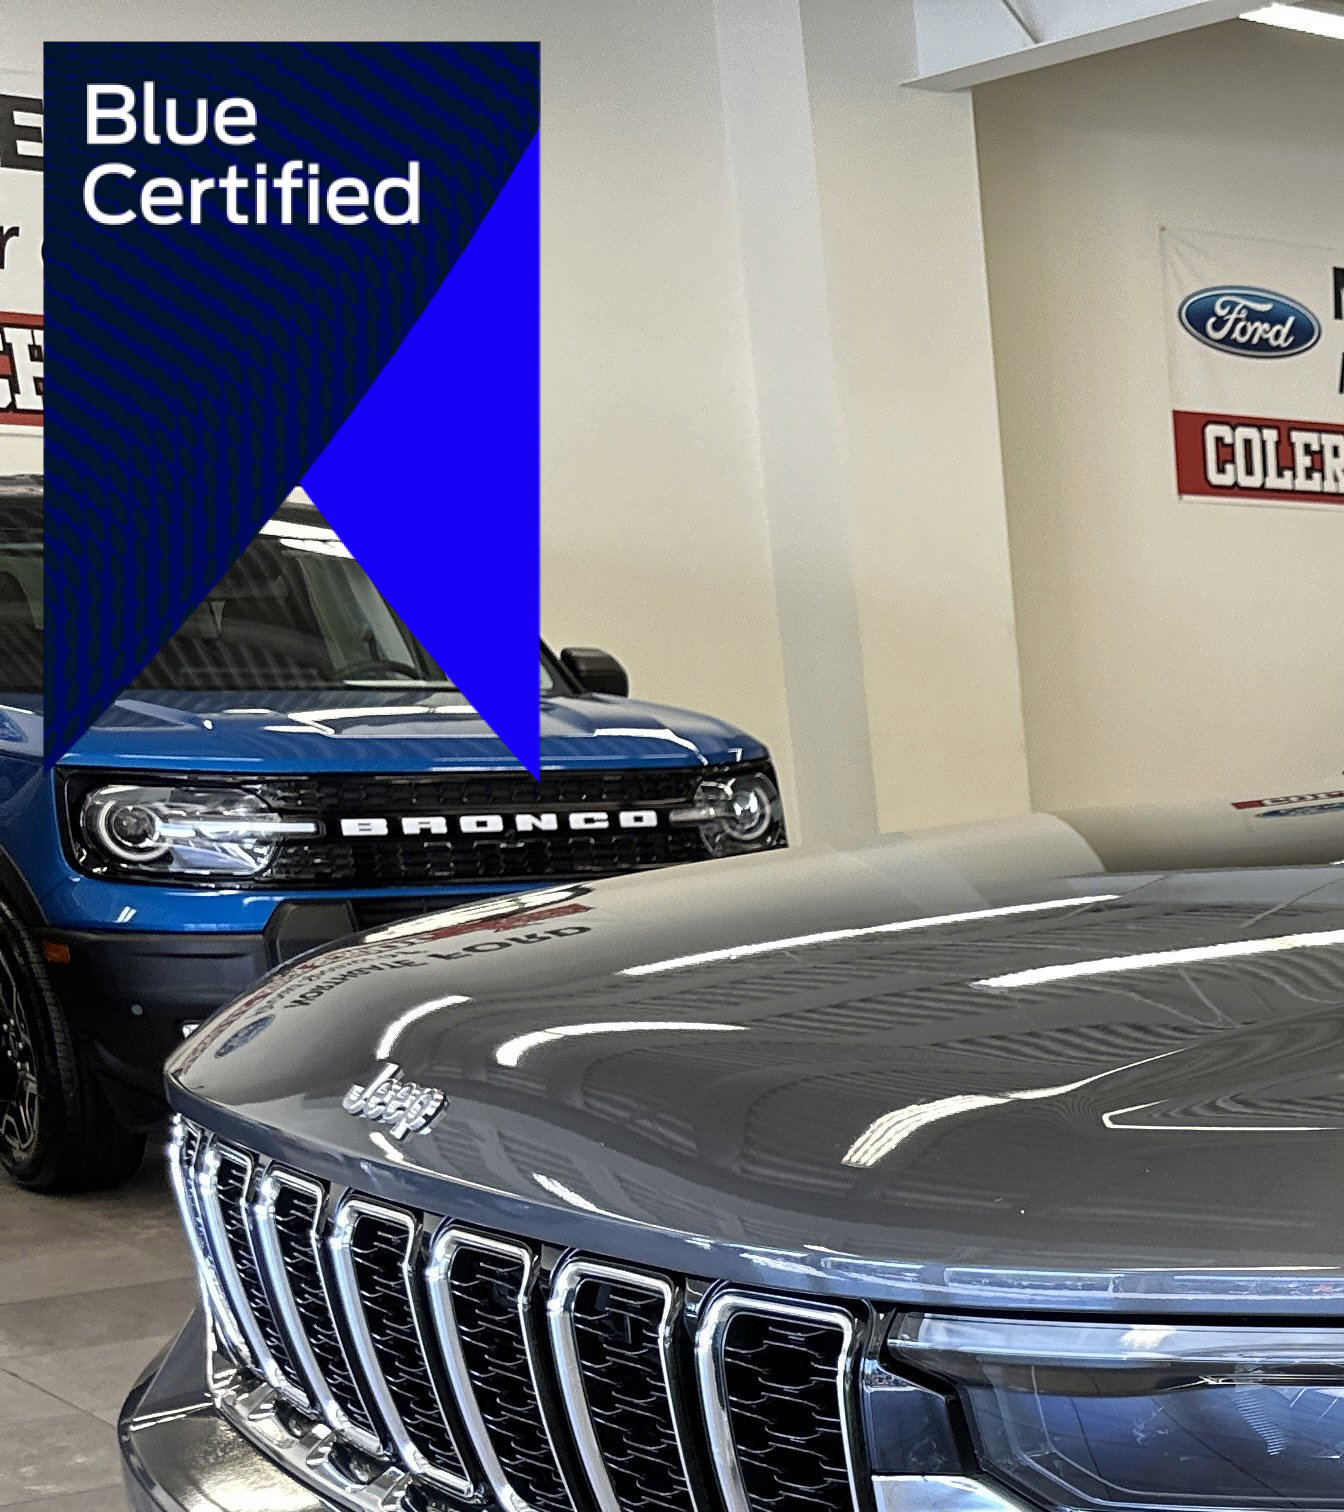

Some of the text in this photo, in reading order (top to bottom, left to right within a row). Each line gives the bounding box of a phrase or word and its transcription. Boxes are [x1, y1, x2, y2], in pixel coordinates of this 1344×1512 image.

[1204, 295, 1296, 349] Ford
[340, 809, 658, 837] BRONCO
[342, 1061, 448, 1141] Jeep
